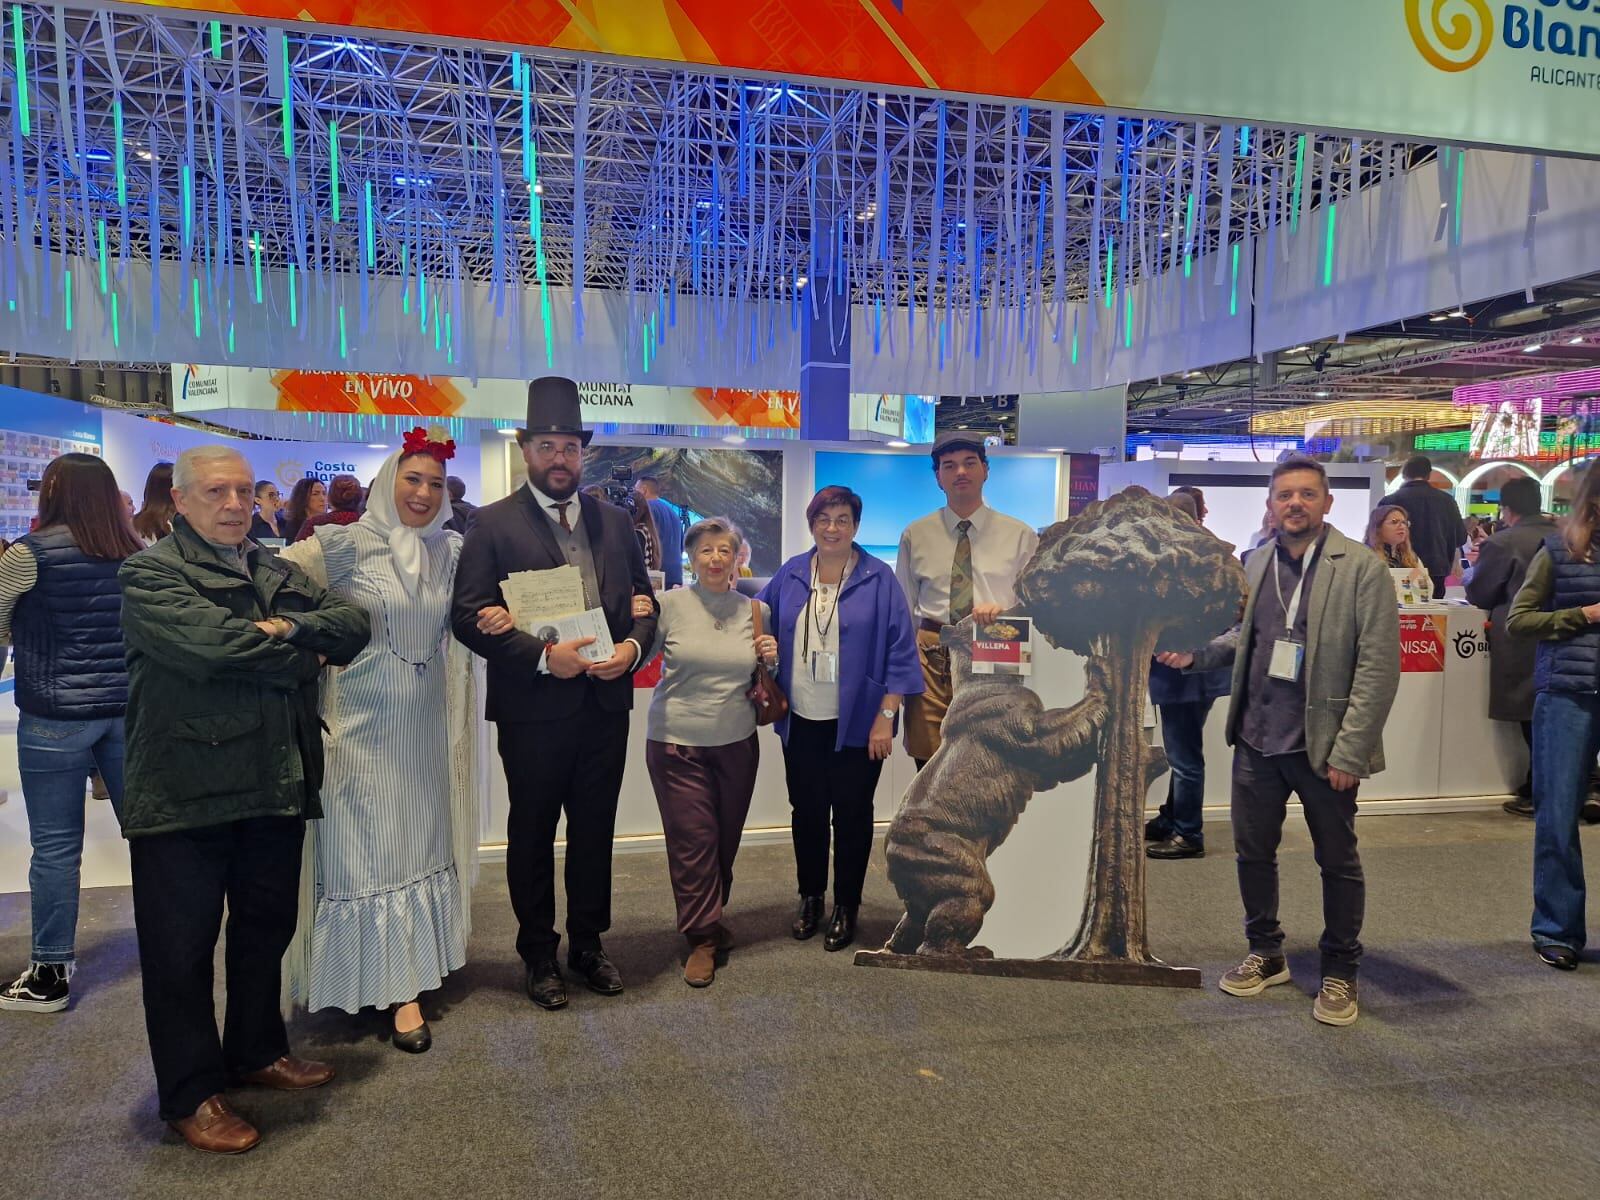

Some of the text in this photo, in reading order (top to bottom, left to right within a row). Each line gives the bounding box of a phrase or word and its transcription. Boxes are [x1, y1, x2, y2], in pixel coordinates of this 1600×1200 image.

[1503, 5, 1600, 58] Blan
[188, 387, 218, 396] VALENCIANA
[345, 380, 364, 394] EN
[579, 382, 632, 393] MUNITAT
[580, 393, 633, 406] NCIANA
[315, 461, 355, 472] Costa
[306, 471, 336, 481] Blan
[976, 642, 1010, 650] VILLENA
[1400, 641, 1437, 653] NISSA
